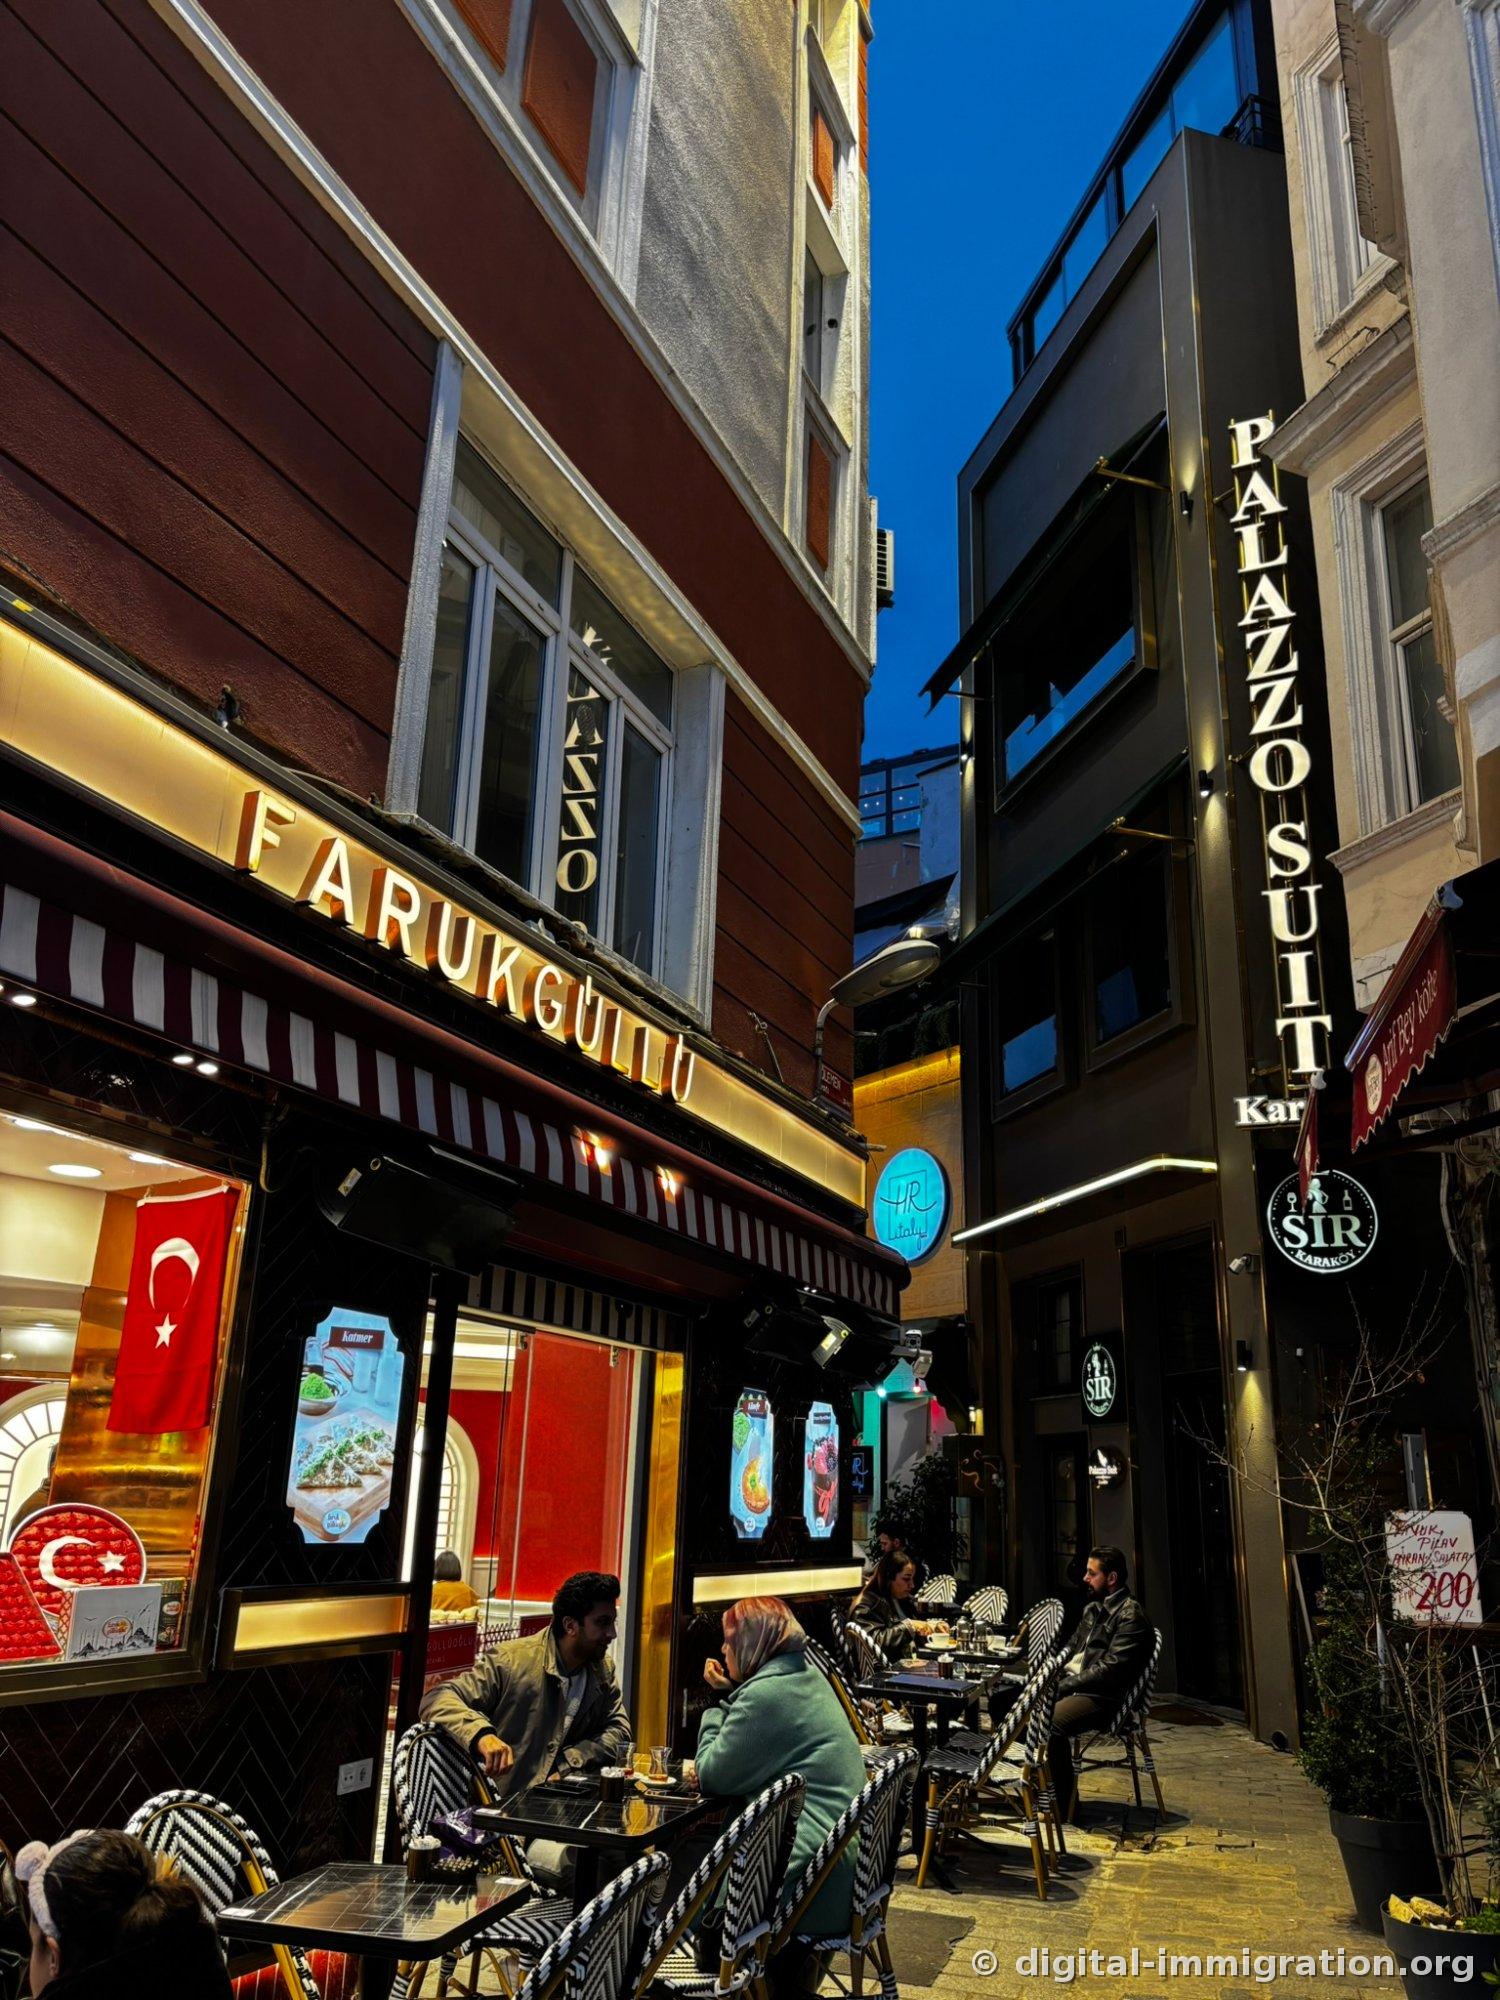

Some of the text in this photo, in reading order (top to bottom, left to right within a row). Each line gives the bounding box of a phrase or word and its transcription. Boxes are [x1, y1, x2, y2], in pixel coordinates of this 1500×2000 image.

[1228, 417, 1332, 1074] PALAZZO SUIT
[1397, 1001, 1415, 1054] Bey
[1236, 1095, 1305, 1125] Kar
[1281, 1214, 1367, 1249] SIR
[1294, 1248, 1357, 1268] KARAKÖY
[341, 1330, 374, 1344] Katmer
[1415, 1571, 1475, 1611] 200
